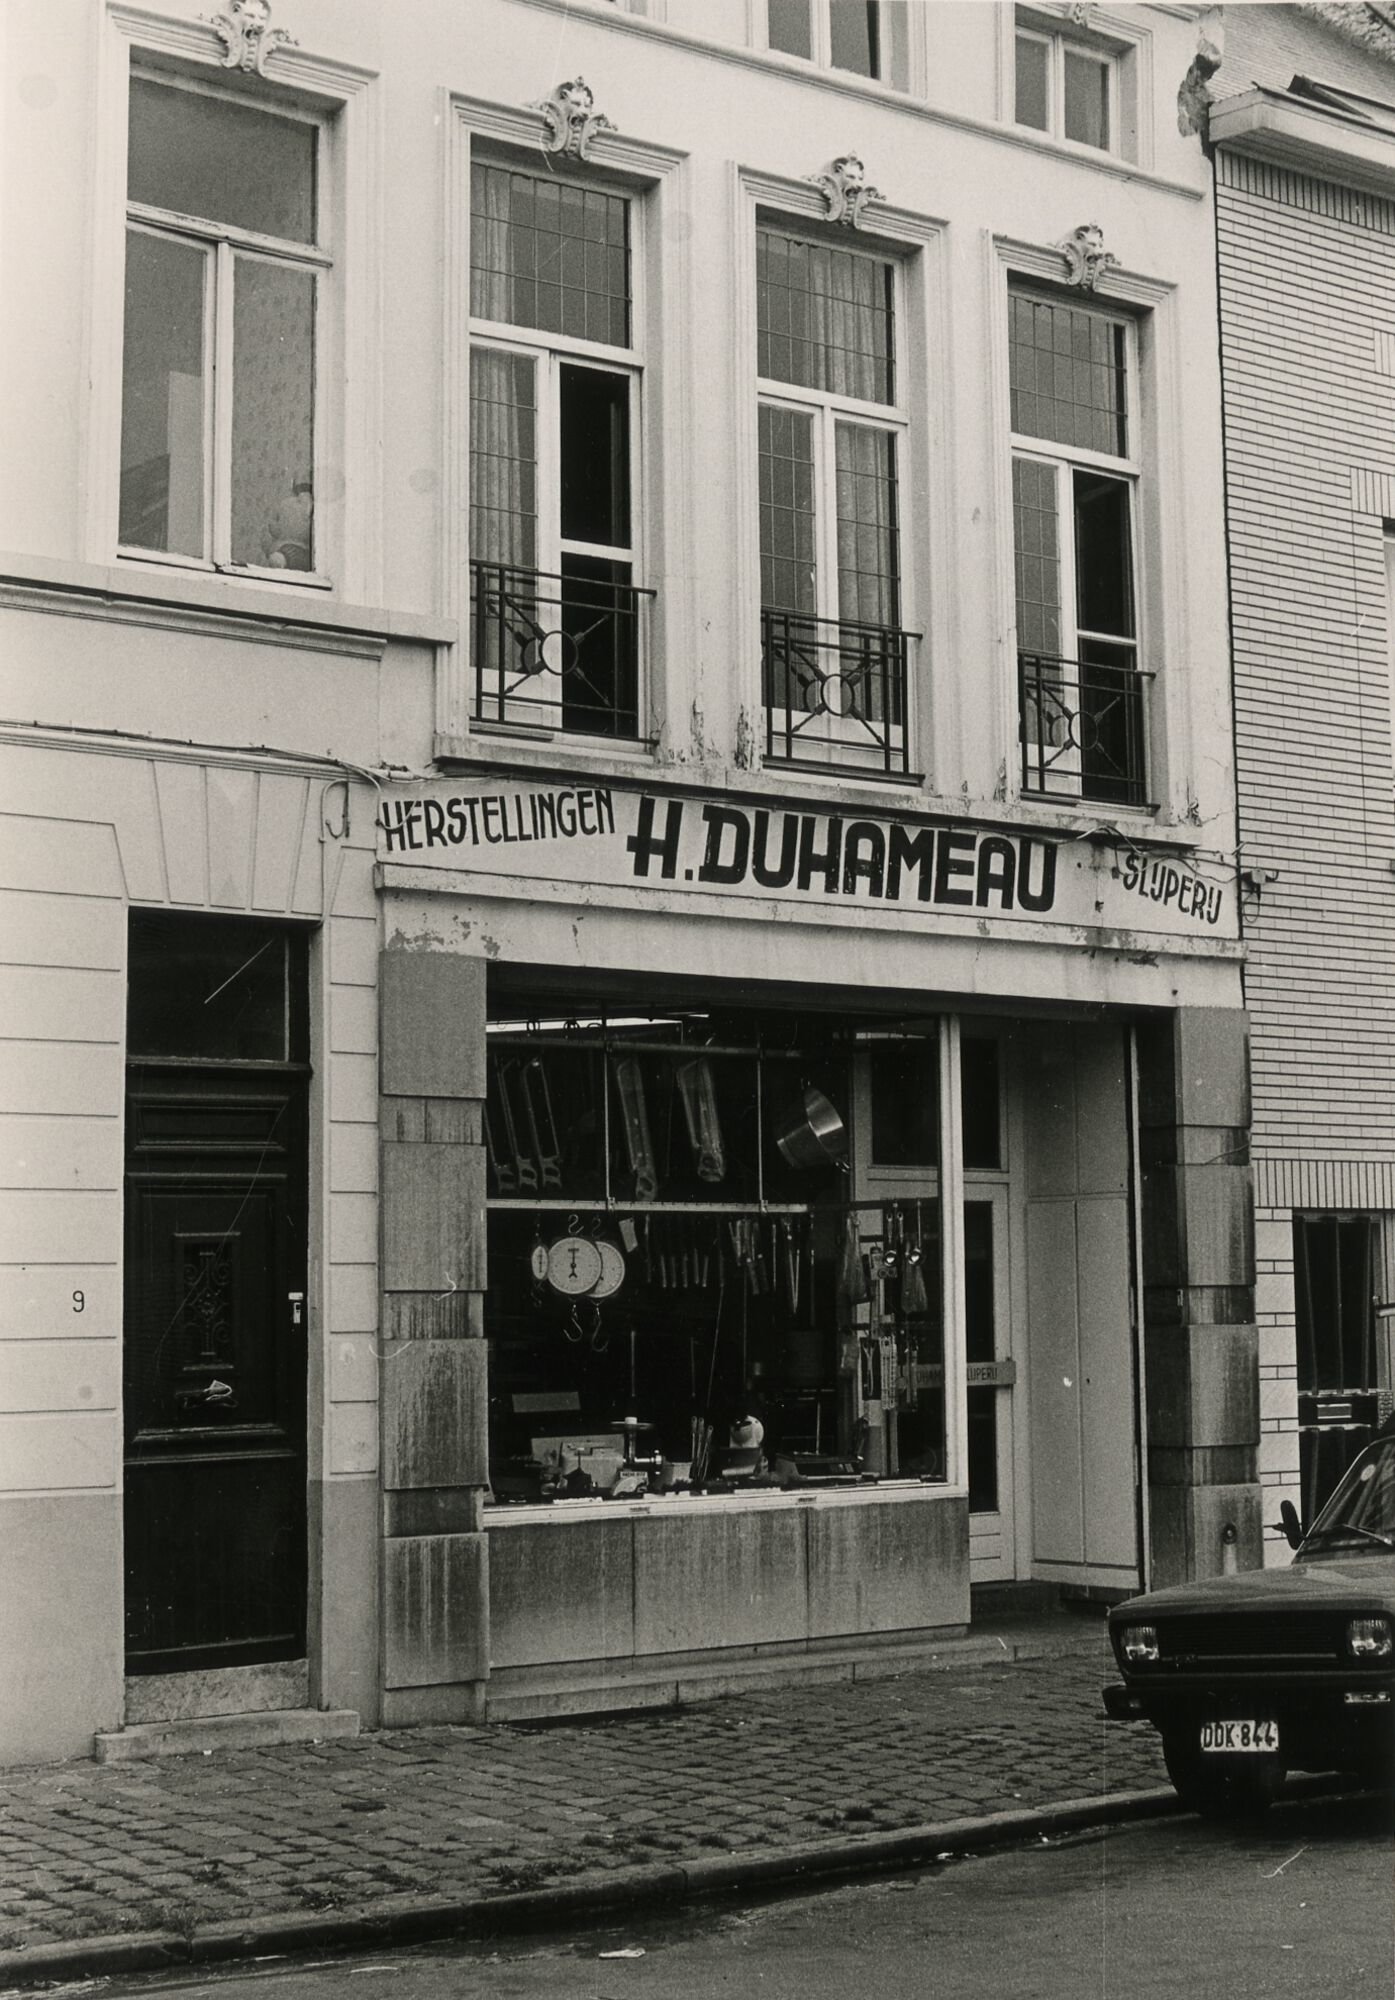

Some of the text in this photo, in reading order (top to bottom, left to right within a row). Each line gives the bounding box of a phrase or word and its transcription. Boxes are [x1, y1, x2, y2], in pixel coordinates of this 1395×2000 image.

[382, 789, 616, 851] HERSTELLINGEN
[1122, 853, 1223, 925] SLIJPERIJ
[72, 1290, 85, 1312] 9
